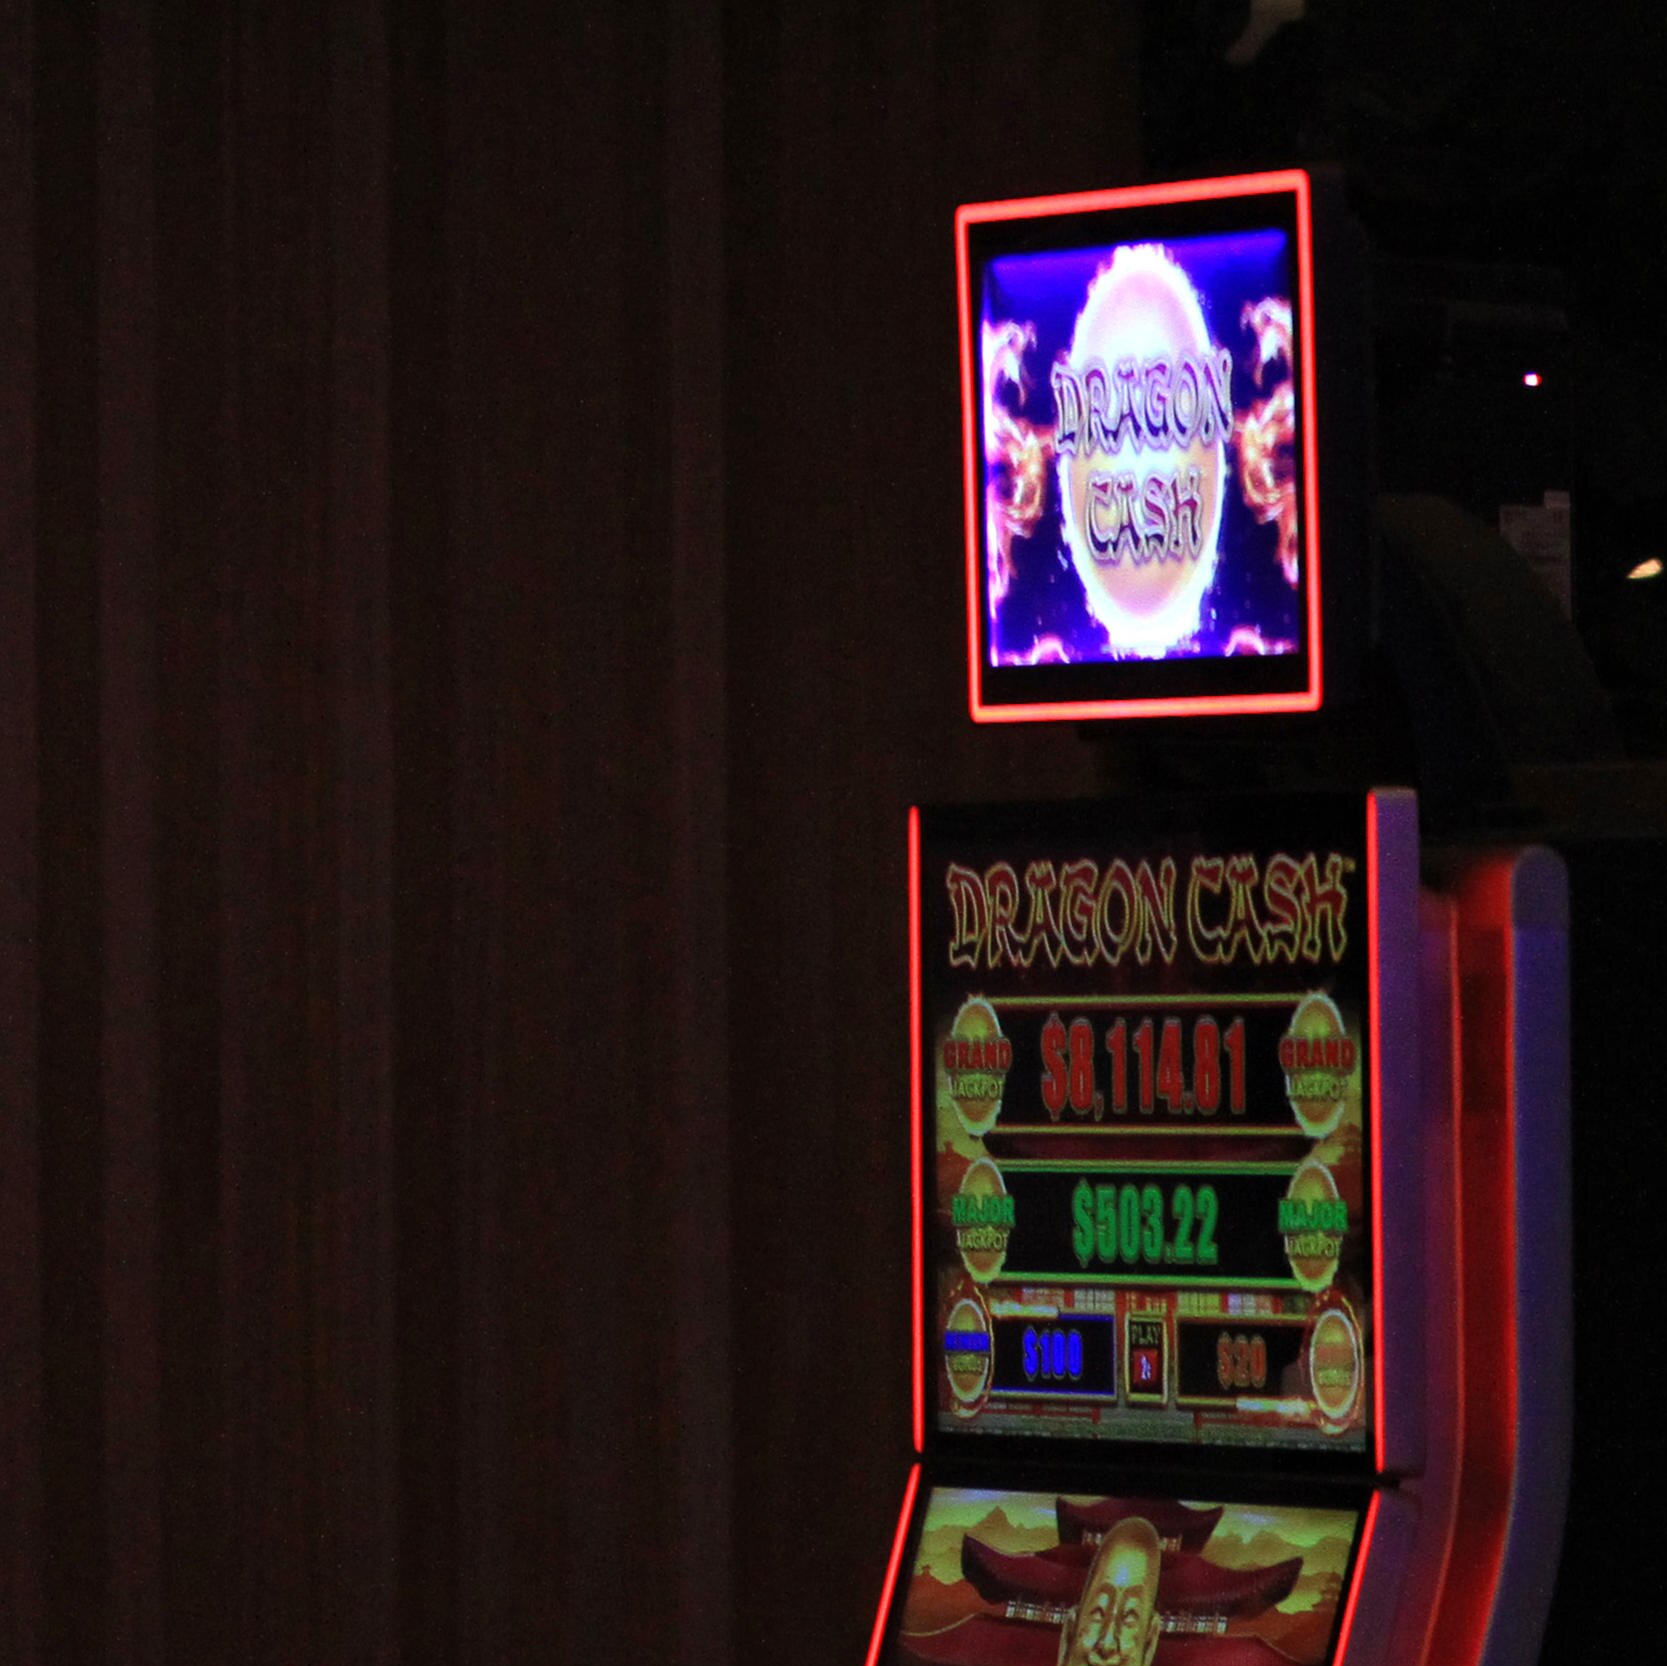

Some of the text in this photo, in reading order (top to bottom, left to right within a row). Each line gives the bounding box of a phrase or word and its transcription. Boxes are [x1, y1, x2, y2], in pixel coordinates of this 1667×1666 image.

[1052, 348, 1233, 454] DRAGON
[1084, 468, 1202, 565] CASH
[947, 853, 1347, 969] DRAGON CASH
[943, 1038, 1013, 1070] GRAND
[1040, 1012, 1246, 1121] $8,114.81
[1279, 1037, 1356, 1071] GRAND
[953, 1193, 1015, 1227] MAJOR
[1072, 1178, 1218, 1268] $503.22
[1278, 1199, 1348, 1233] MAJOR
[1023, 1326, 1083, 1382] $100
